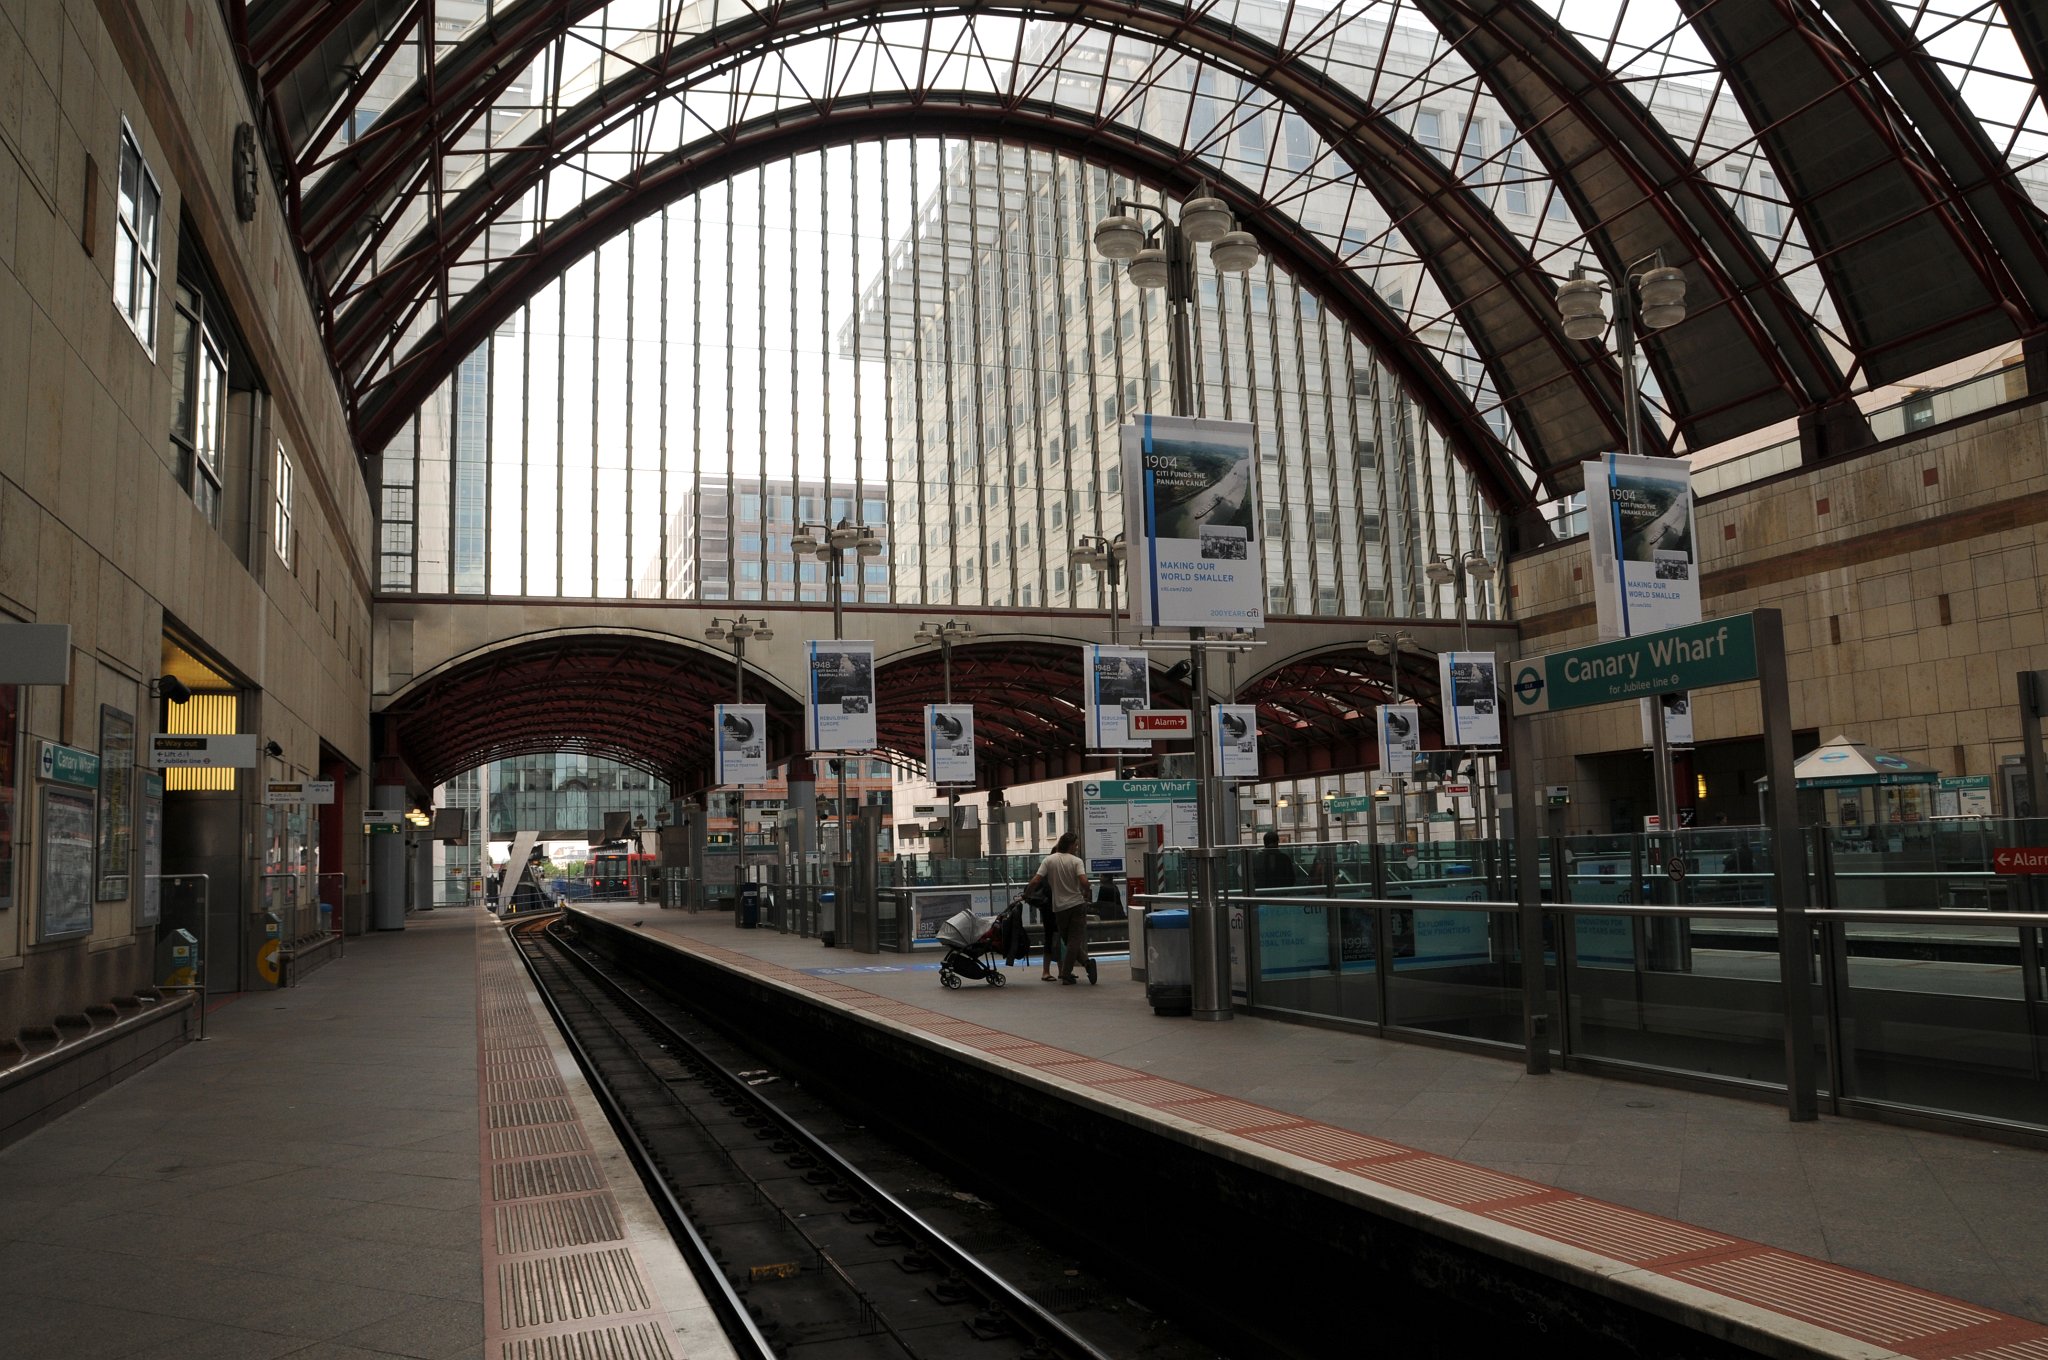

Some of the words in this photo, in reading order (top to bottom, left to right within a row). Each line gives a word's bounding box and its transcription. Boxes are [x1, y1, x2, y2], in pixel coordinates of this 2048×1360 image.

[1145, 455, 1177, 469] 1904
[1156, 478, 1184, 486] PANAMA
[1611, 489, 1636, 500] 1904
[1160, 562, 1194, 570] MAKING
[1160, 573, 1191, 581] WORLD
[1194, 574, 1234, 582] SMALLER
[1628, 591, 1650, 599] WORLD
[1652, 592, 1680, 600] SMALLER
[1564, 651, 1640, 683] Canary
[1648, 626, 1728, 668] Wharf
[812, 661, 831, 669] 1948
[1609, 684, 1621, 695] for
[1623, 680, 1650, 692] Jubilee
[1653, 677, 1669, 688] line
[1154, 717, 1178, 726] Alarm
[164, 740, 182, 748] Way
[58, 750, 78, 774] Canary
[79, 755, 95, 774] Wharf
[1966, 776, 1984, 784] Wharf
[1122, 782, 1157, 793] Canary
[1160, 781, 1191, 791] Wharf
[1333, 800, 1350, 809] Canary
[1350, 798, 1365, 806] Wharf
[1230, 918, 1243, 929] citi
[1417, 928, 1433, 937] NEW
[1434, 926, 1471, 935] FRONTIERS
